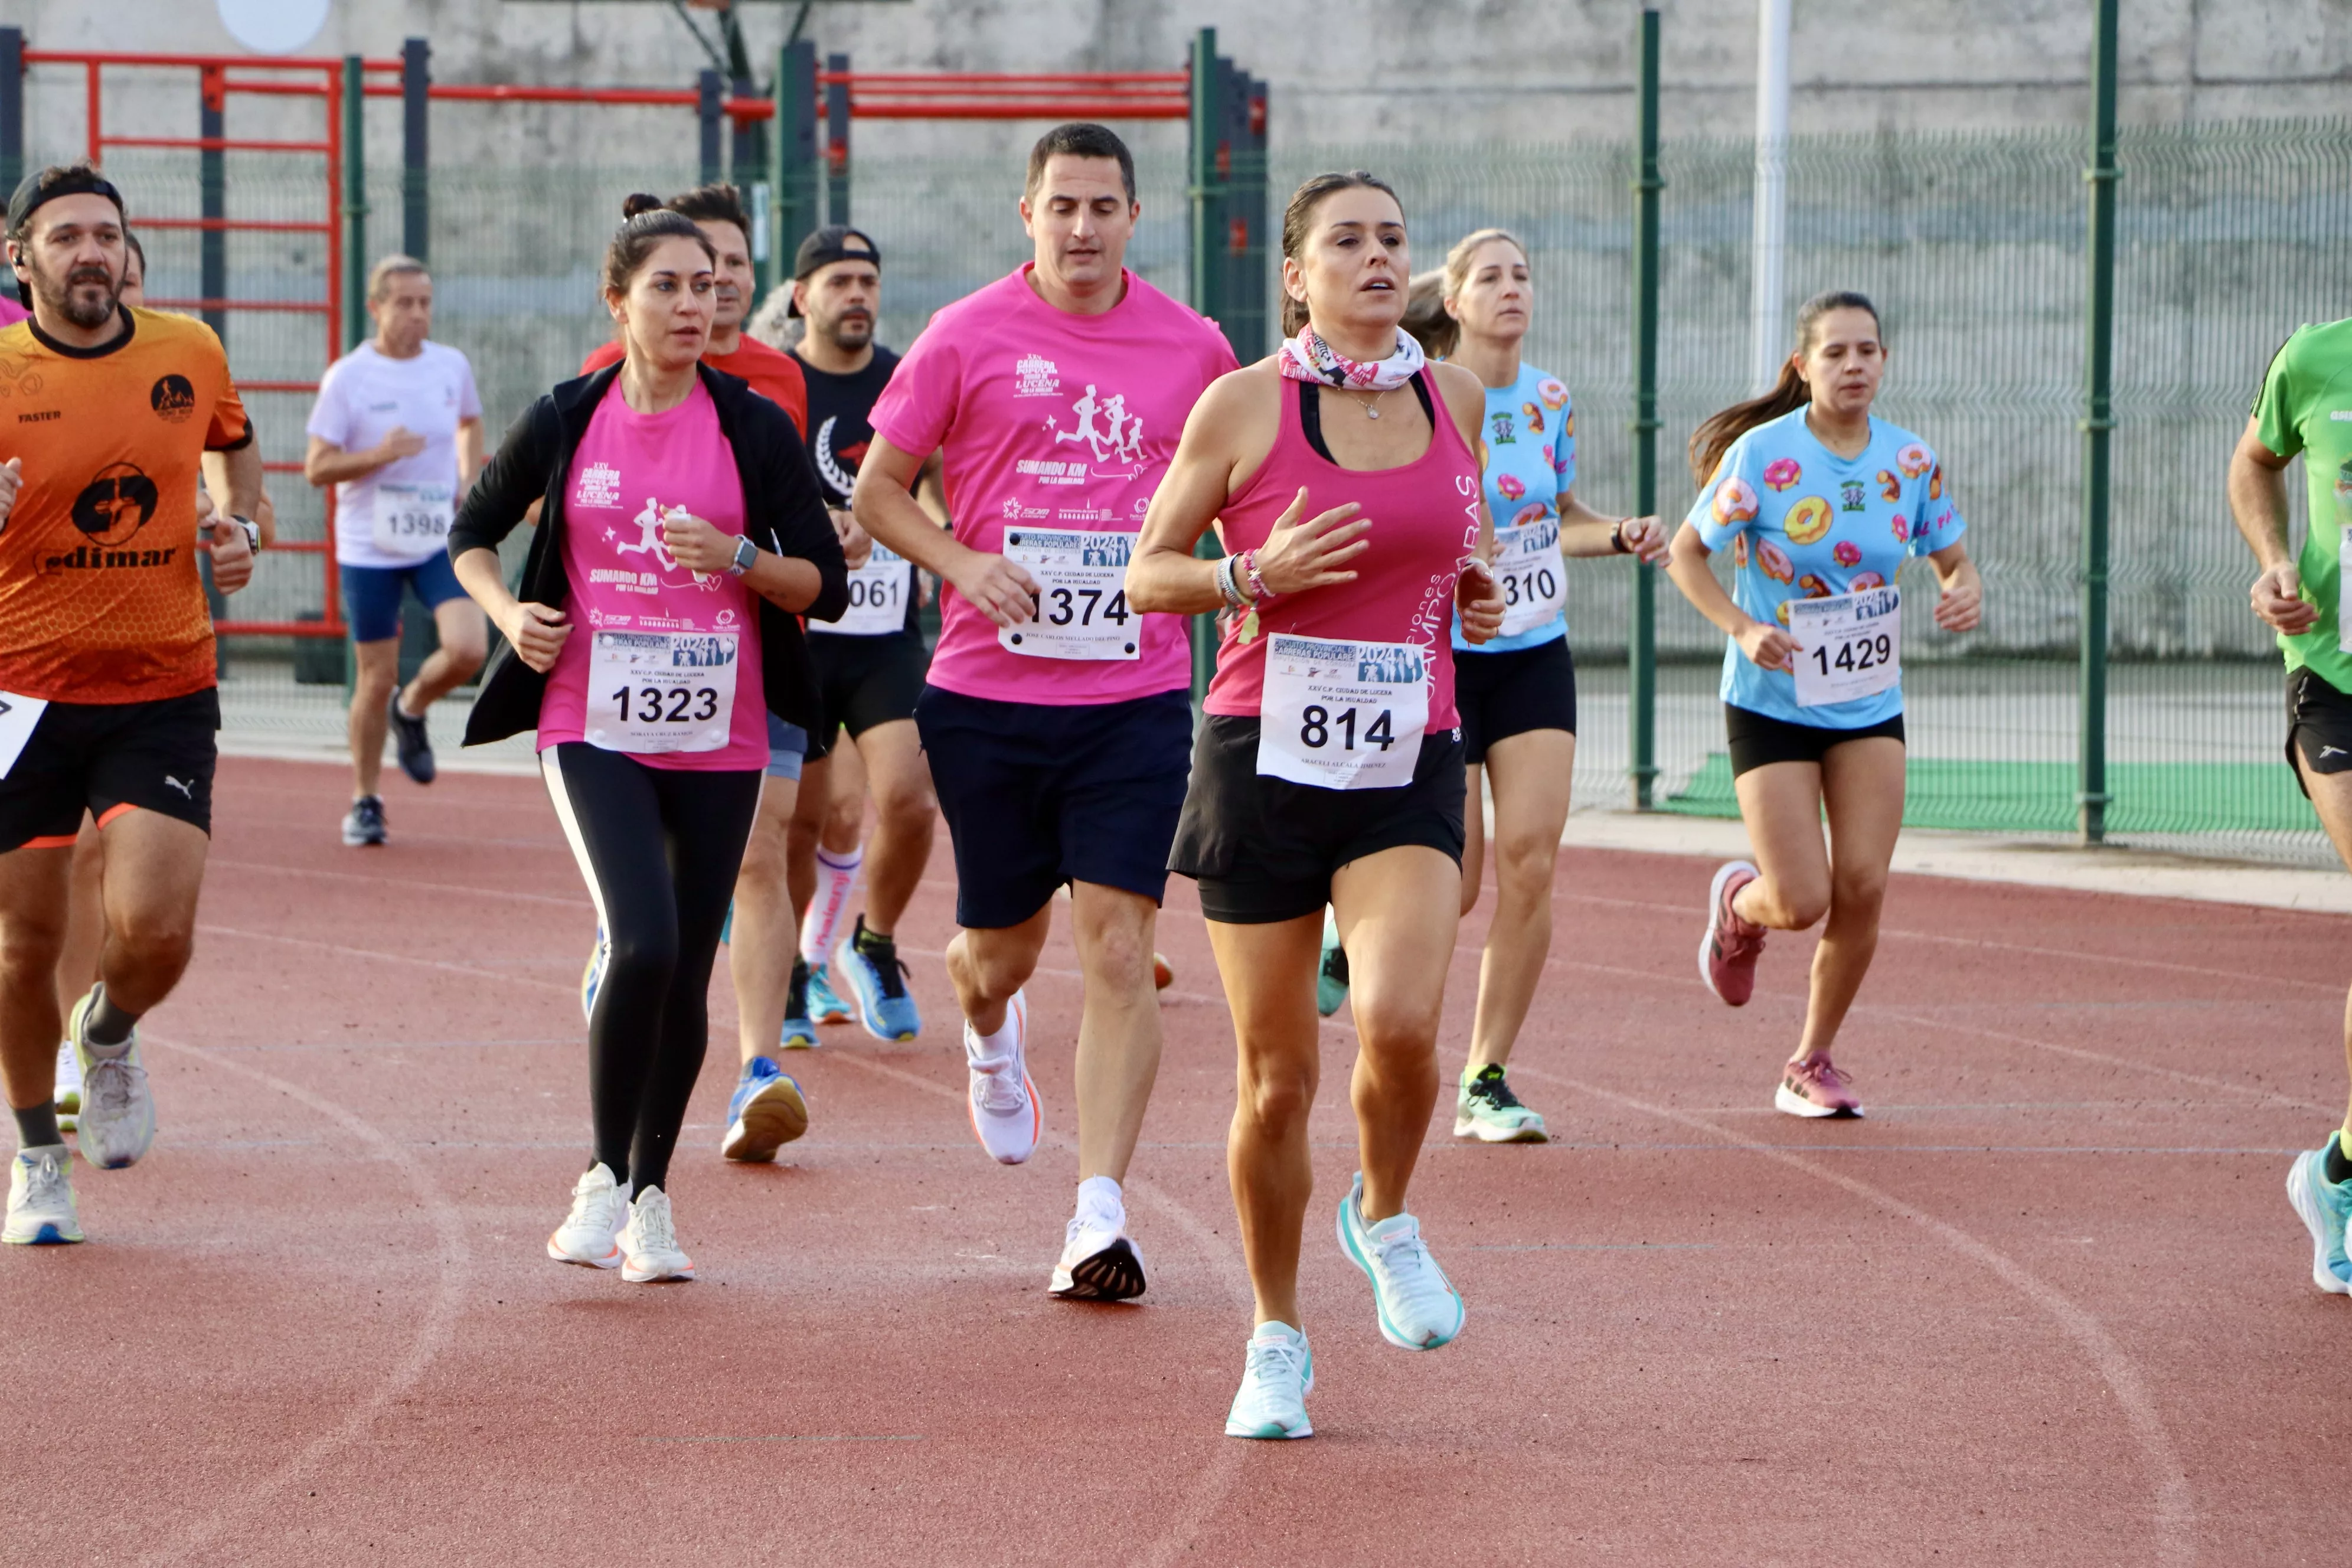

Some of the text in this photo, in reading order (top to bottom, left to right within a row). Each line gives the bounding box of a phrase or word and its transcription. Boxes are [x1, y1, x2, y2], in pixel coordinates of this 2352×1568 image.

[1015, 378, 1060, 388] LUCENA
[18, 411, 61, 423] FASTER
[593, 462, 608, 470] XXV
[1016, 459, 1087, 477] SUMANDO KM
[576, 490, 620, 500] LUCENA
[388, 512, 446, 537] 1398
[1083, 535, 1119, 550] 2024
[589, 569, 658, 586] SUMANDO KM
[627, 584, 633, 592] LA
[849, 579, 898, 607] 061
[1502, 569, 1556, 606] 310
[1030, 588, 1129, 626] 1374
[672, 637, 709, 651] 2024
[1275, 639, 1305, 649] CIRCUITO
[1306, 643, 1345, 652] PROVINCIAL
[1358, 646, 1396, 663] 2024
[1275, 647, 1357, 662] CARRERAS POPULARES
[1812, 633, 1891, 676] 1429
[613, 686, 718, 723] 1323
[1301, 704, 1395, 751] 814
[1301, 758, 1329, 766] ARACELI
